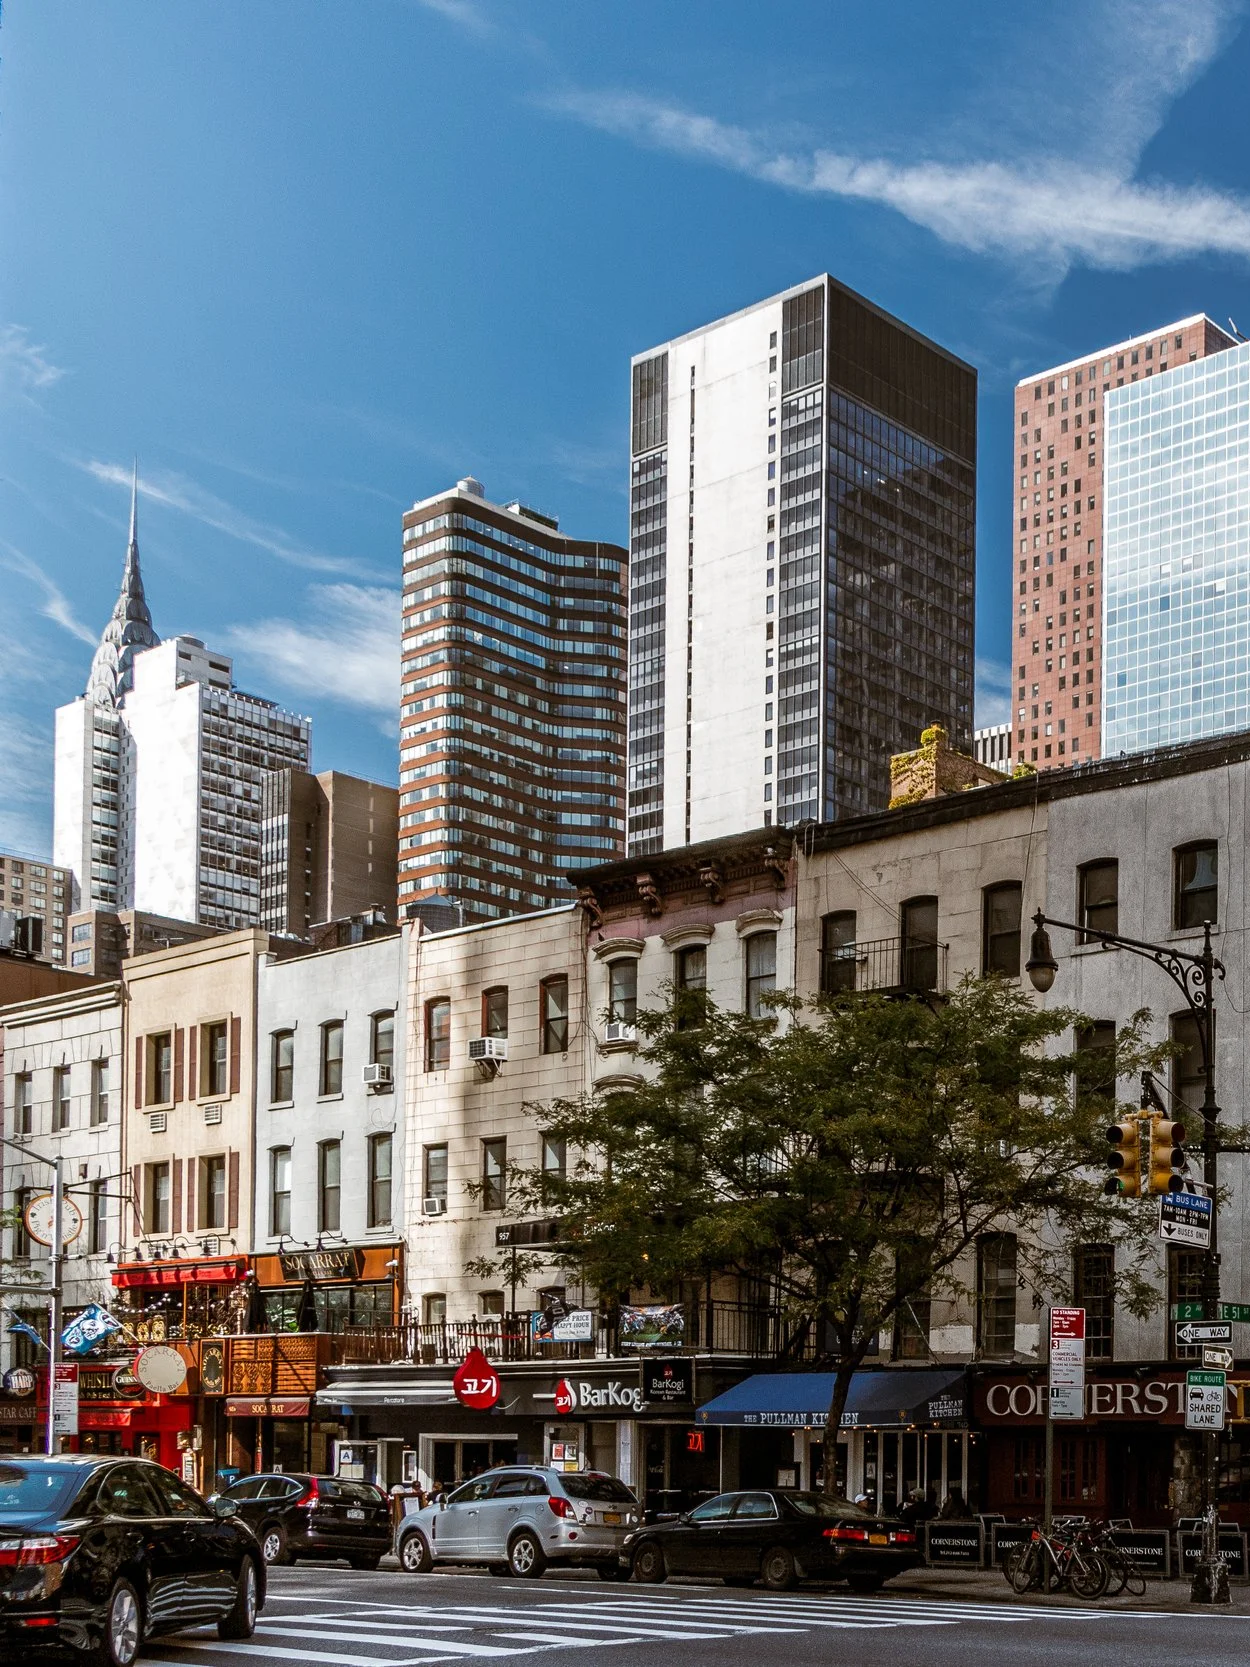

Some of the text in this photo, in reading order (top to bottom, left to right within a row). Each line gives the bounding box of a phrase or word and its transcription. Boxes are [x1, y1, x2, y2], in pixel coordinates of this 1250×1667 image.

[1176, 1195, 1208, 1209] BUS LANE
[499, 1232, 510, 1240] 957
[1178, 1228, 1207, 1240] BUSES ONLY
[1185, 1305, 1192, 1318] 2
[1224, 1306, 1229, 1318] E
[1232, 1307, 1240, 1319] 51
[1182, 1328, 1228, 1338] ONE WAY
[1053, 1341, 1058, 1349] 3
[140, 1347, 184, 1373] SOCARRAT
[1205, 1352, 1216, 1361] ONE
[11, 1375, 33, 1389] HARP
[80, 1373, 112, 1388] WHISTL
[1204, 1375, 1222, 1383] ROUTE
[461, 1376, 497, 1397] 고기
[652, 1379, 684, 1391] BarKogi
[580, 1382, 648, 1412] BarKog
[252, 1405, 284, 1413] SOCARAT
[928, 1400, 963, 1410] PULLMAN
[1189, 1404, 1221, 1413] SHARED
[744, 1415, 757, 1423] THE
[760, 1412, 806, 1424] PULLMAN
[929, 1409, 963, 1418] KITCHEN
[1194, 1416, 1215, 1424] LANE
[343, 1452, 350, 1460] A
[229, 1475, 235, 1483] P
[931, 1538, 978, 1547] CORNERSTONE
